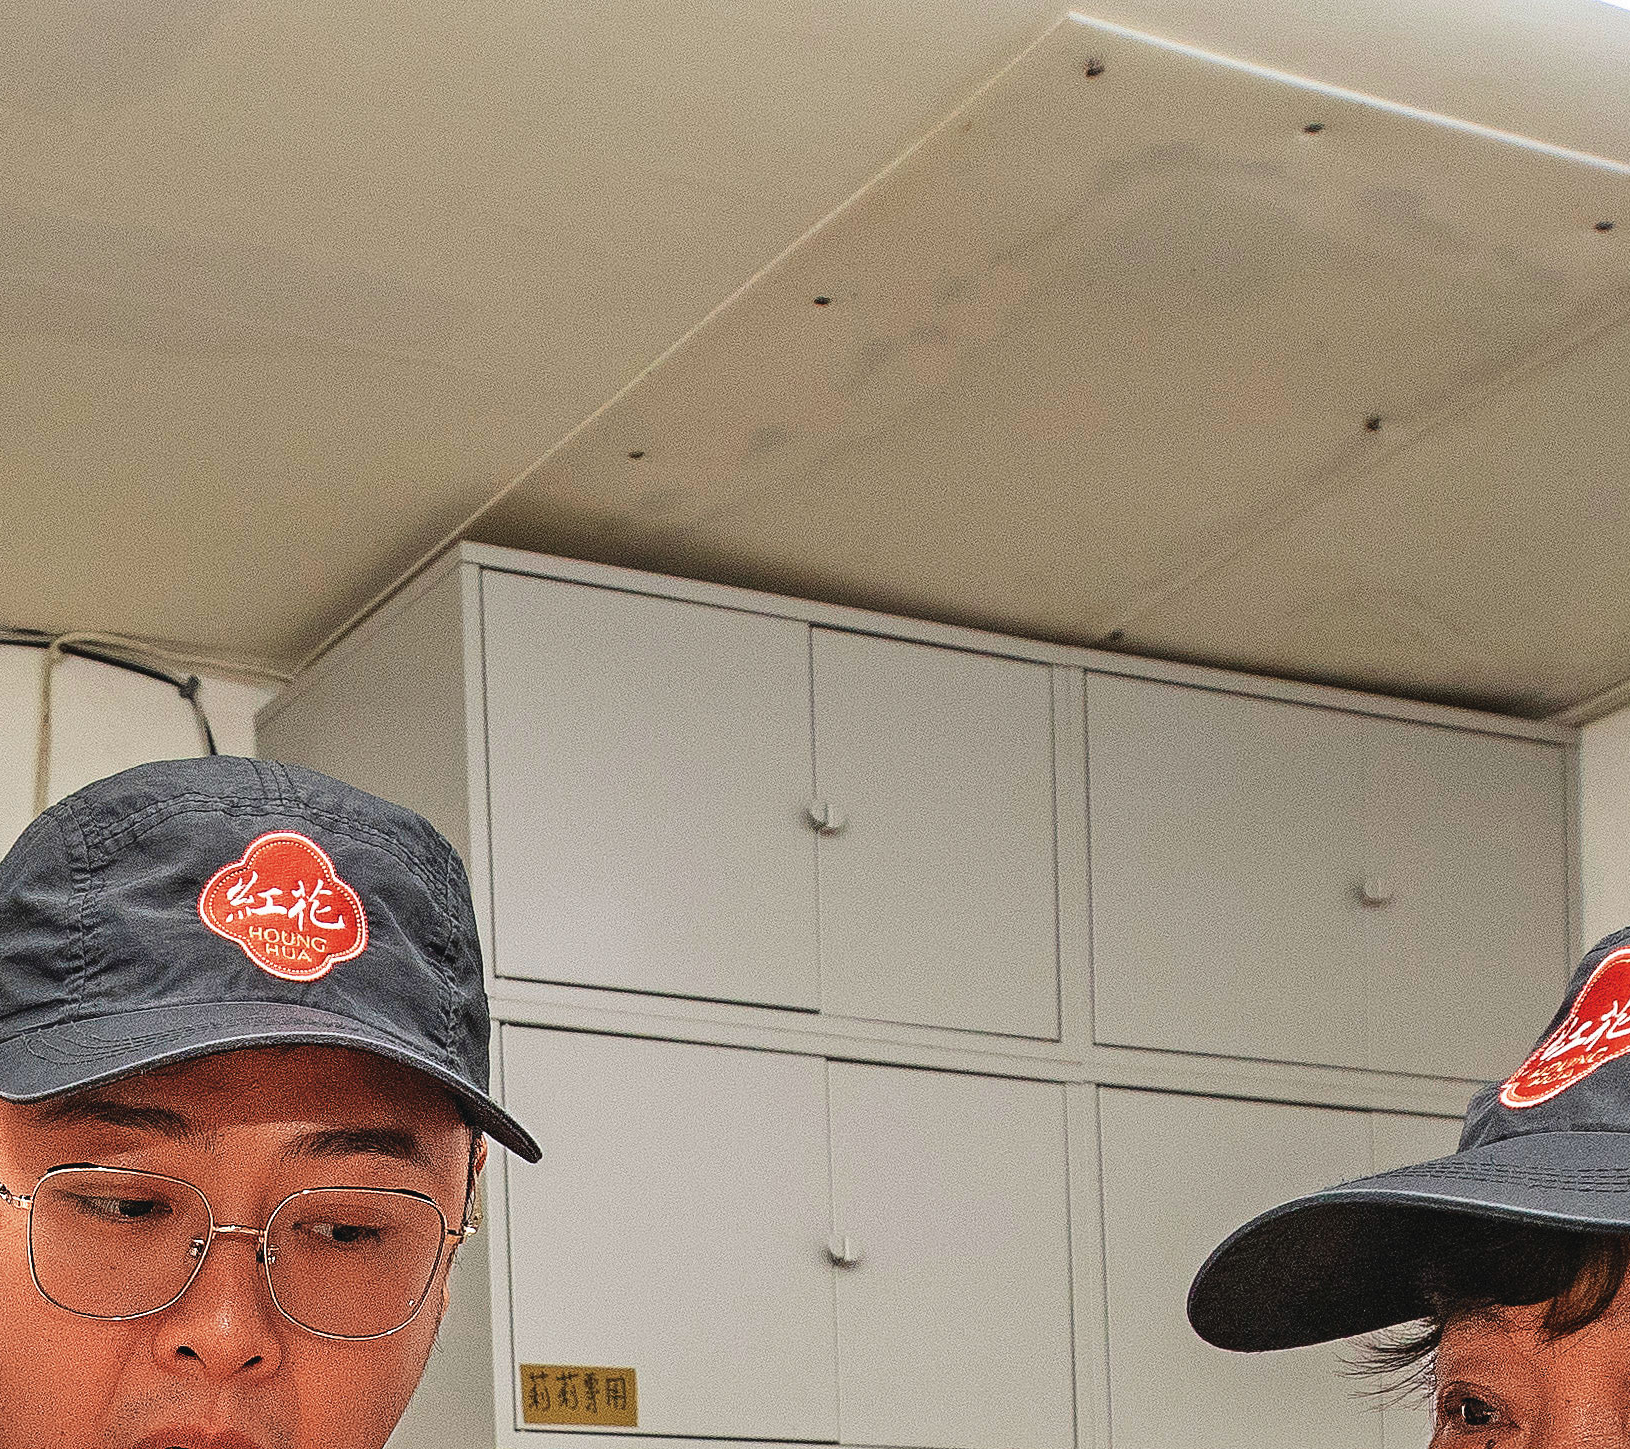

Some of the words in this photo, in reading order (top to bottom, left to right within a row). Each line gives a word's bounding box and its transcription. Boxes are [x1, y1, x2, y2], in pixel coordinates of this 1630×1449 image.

[225, 870, 346, 932] 紅花
[248, 925, 327, 953] HOUNG
[265, 942, 313, 963] HUA
[528, 1370, 628, 1416] 莉莉專用
